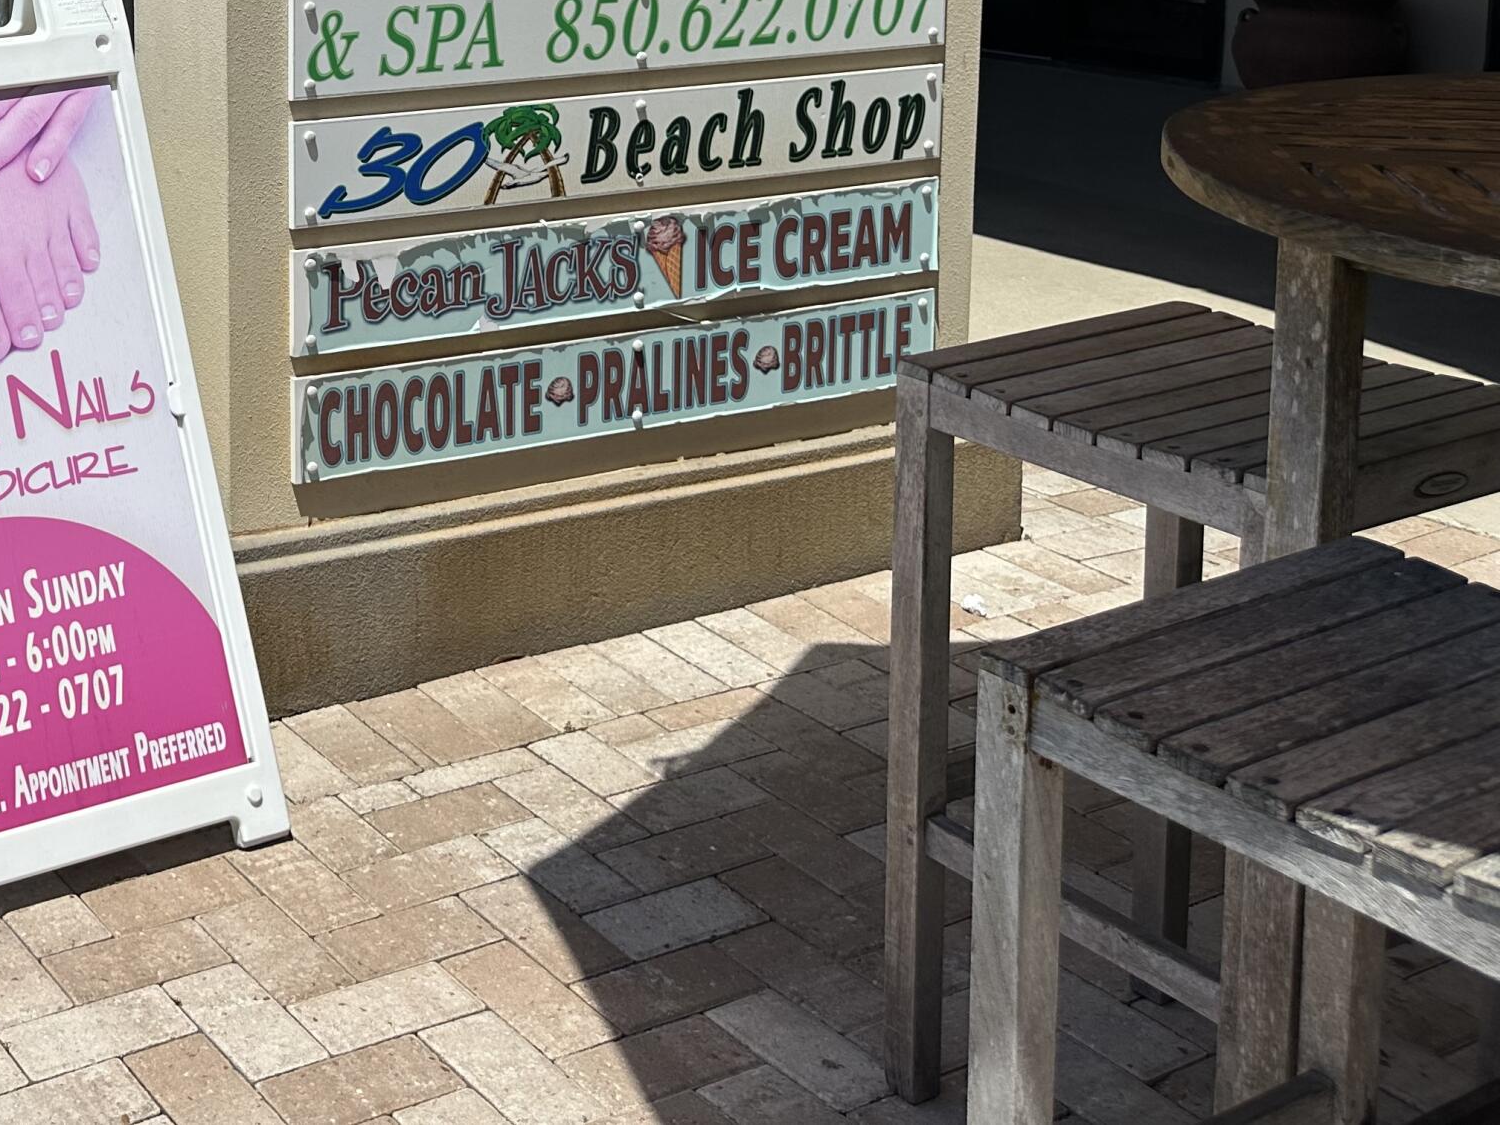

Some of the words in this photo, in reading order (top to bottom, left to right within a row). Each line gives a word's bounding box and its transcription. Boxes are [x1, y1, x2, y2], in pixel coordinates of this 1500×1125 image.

[306, 9, 360, 83] &
[378, 0, 506, 77] SPA
[580, 88, 766, 185] Beach
[789, 79, 928, 161] Shop
[322, 257, 487, 333] Pecan
[694, 220, 762, 292] ICE
[774, 201, 914, 279] CREAM
[6, 349, 156, 440] NAILS
[318, 359, 544, 468] CHOCOLATE
[576, 328, 750, 427] PRALINES
[781, 304, 914, 394] BRITTLE
[22, 561, 127, 620] SUNDAY
[24, 619, 118, 674] 6:00PM
[57, 664, 125, 720] 0707
[13, 746, 131, 810] APPOINTMENT
[133, 720, 228, 774] PREFERRED
